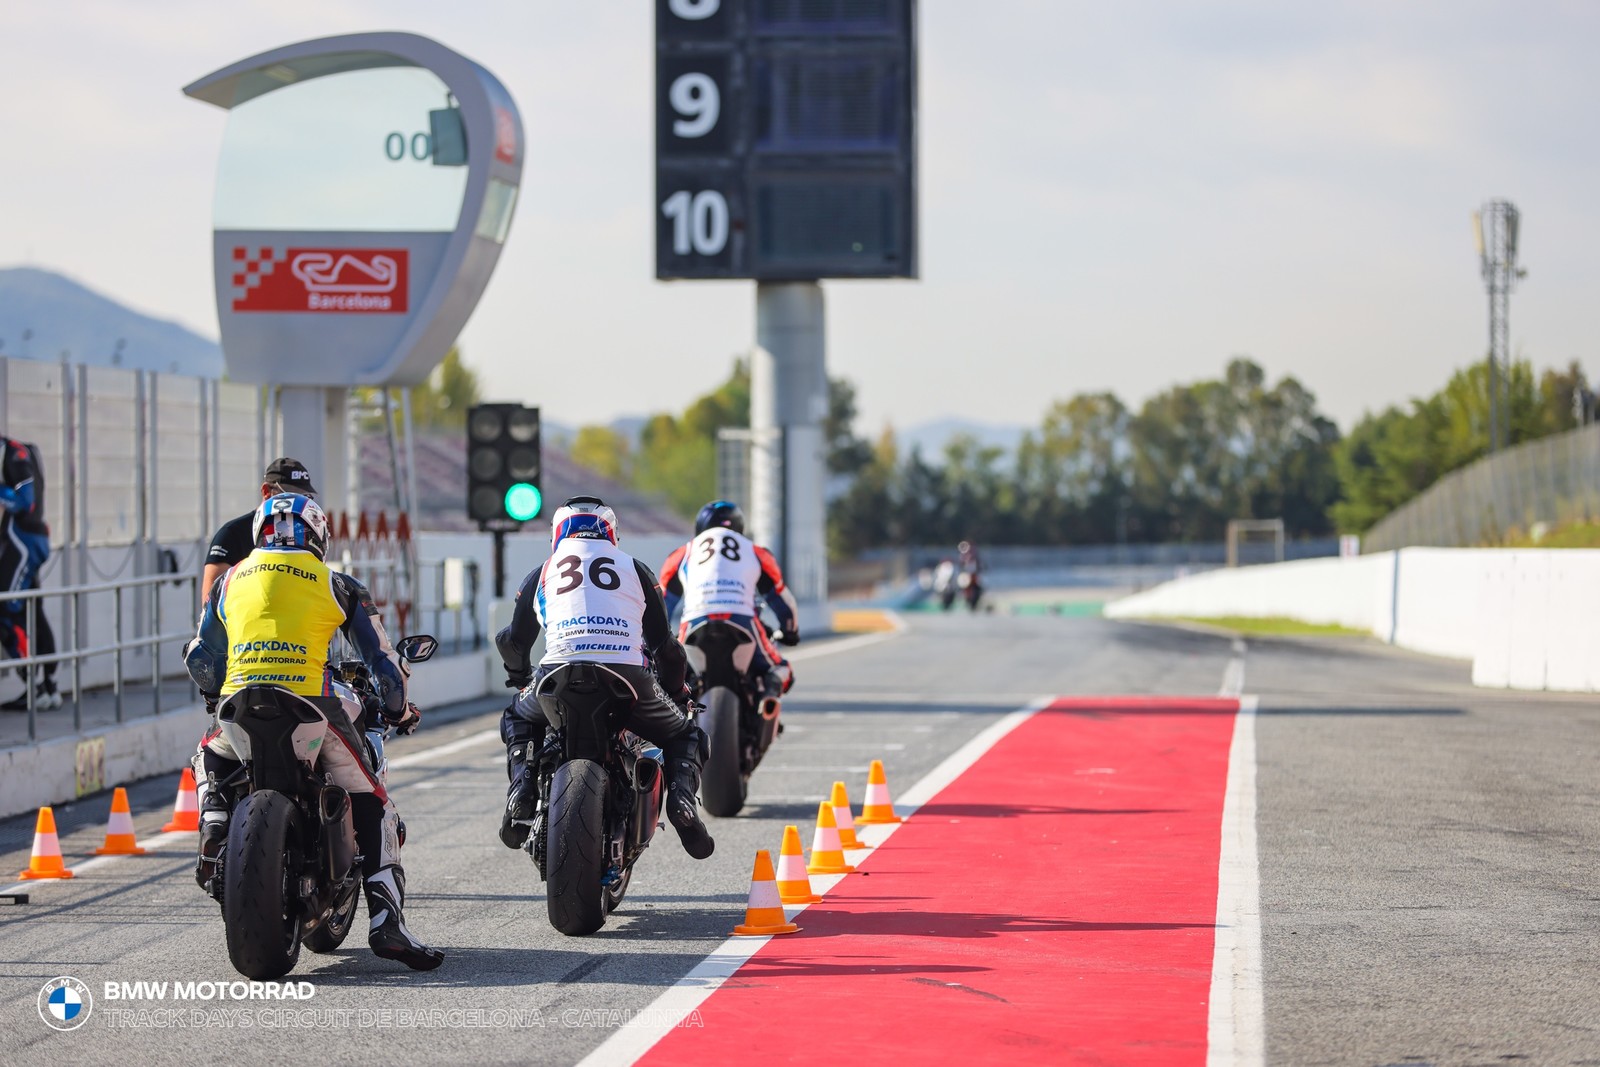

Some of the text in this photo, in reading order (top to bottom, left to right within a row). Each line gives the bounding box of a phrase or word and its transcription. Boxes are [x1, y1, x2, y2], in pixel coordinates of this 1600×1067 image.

[669, 72, 720, 138] 9
[661, 189, 729, 256] 10
[308, 293, 391, 310] Barcelona
[698, 535, 741, 565] 38
[236, 563, 318, 583] INSTRUCTEUR
[556, 555, 621, 596] 36
[556, 616, 629, 631] TRACKDAYS
[565, 628, 630, 637] BMW MOTORRAD
[232, 640, 308, 656] TRACKDAYS
[575, 643, 631, 652] MICHELIN
[239, 656, 307, 666] BMW MOTORRAD
[246, 674, 307, 683] MICHELIN
